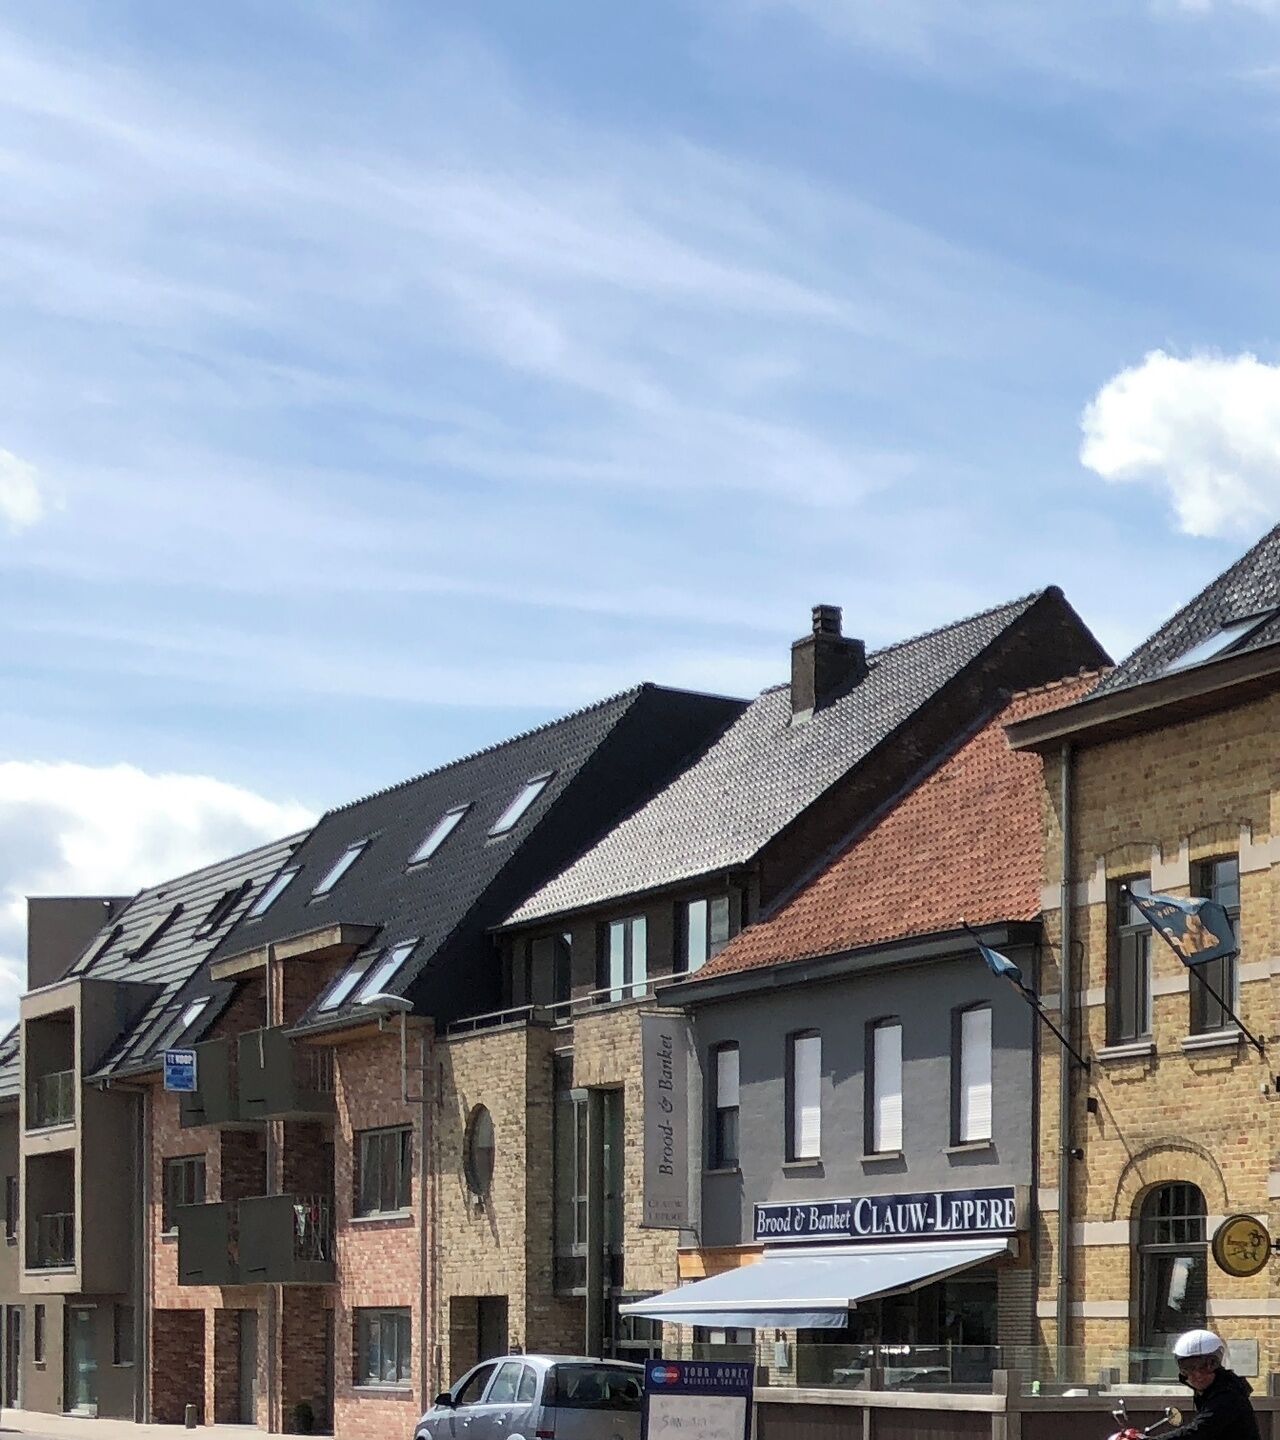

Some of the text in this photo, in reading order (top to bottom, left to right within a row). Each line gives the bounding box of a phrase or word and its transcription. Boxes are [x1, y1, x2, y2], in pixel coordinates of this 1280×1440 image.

[656, 1034, 674, 1176] Brood- & Banket
[756, 1206, 792, 1234] Brood
[793, 1206, 806, 1232] &
[808, 1204, 851, 1232] Banket
